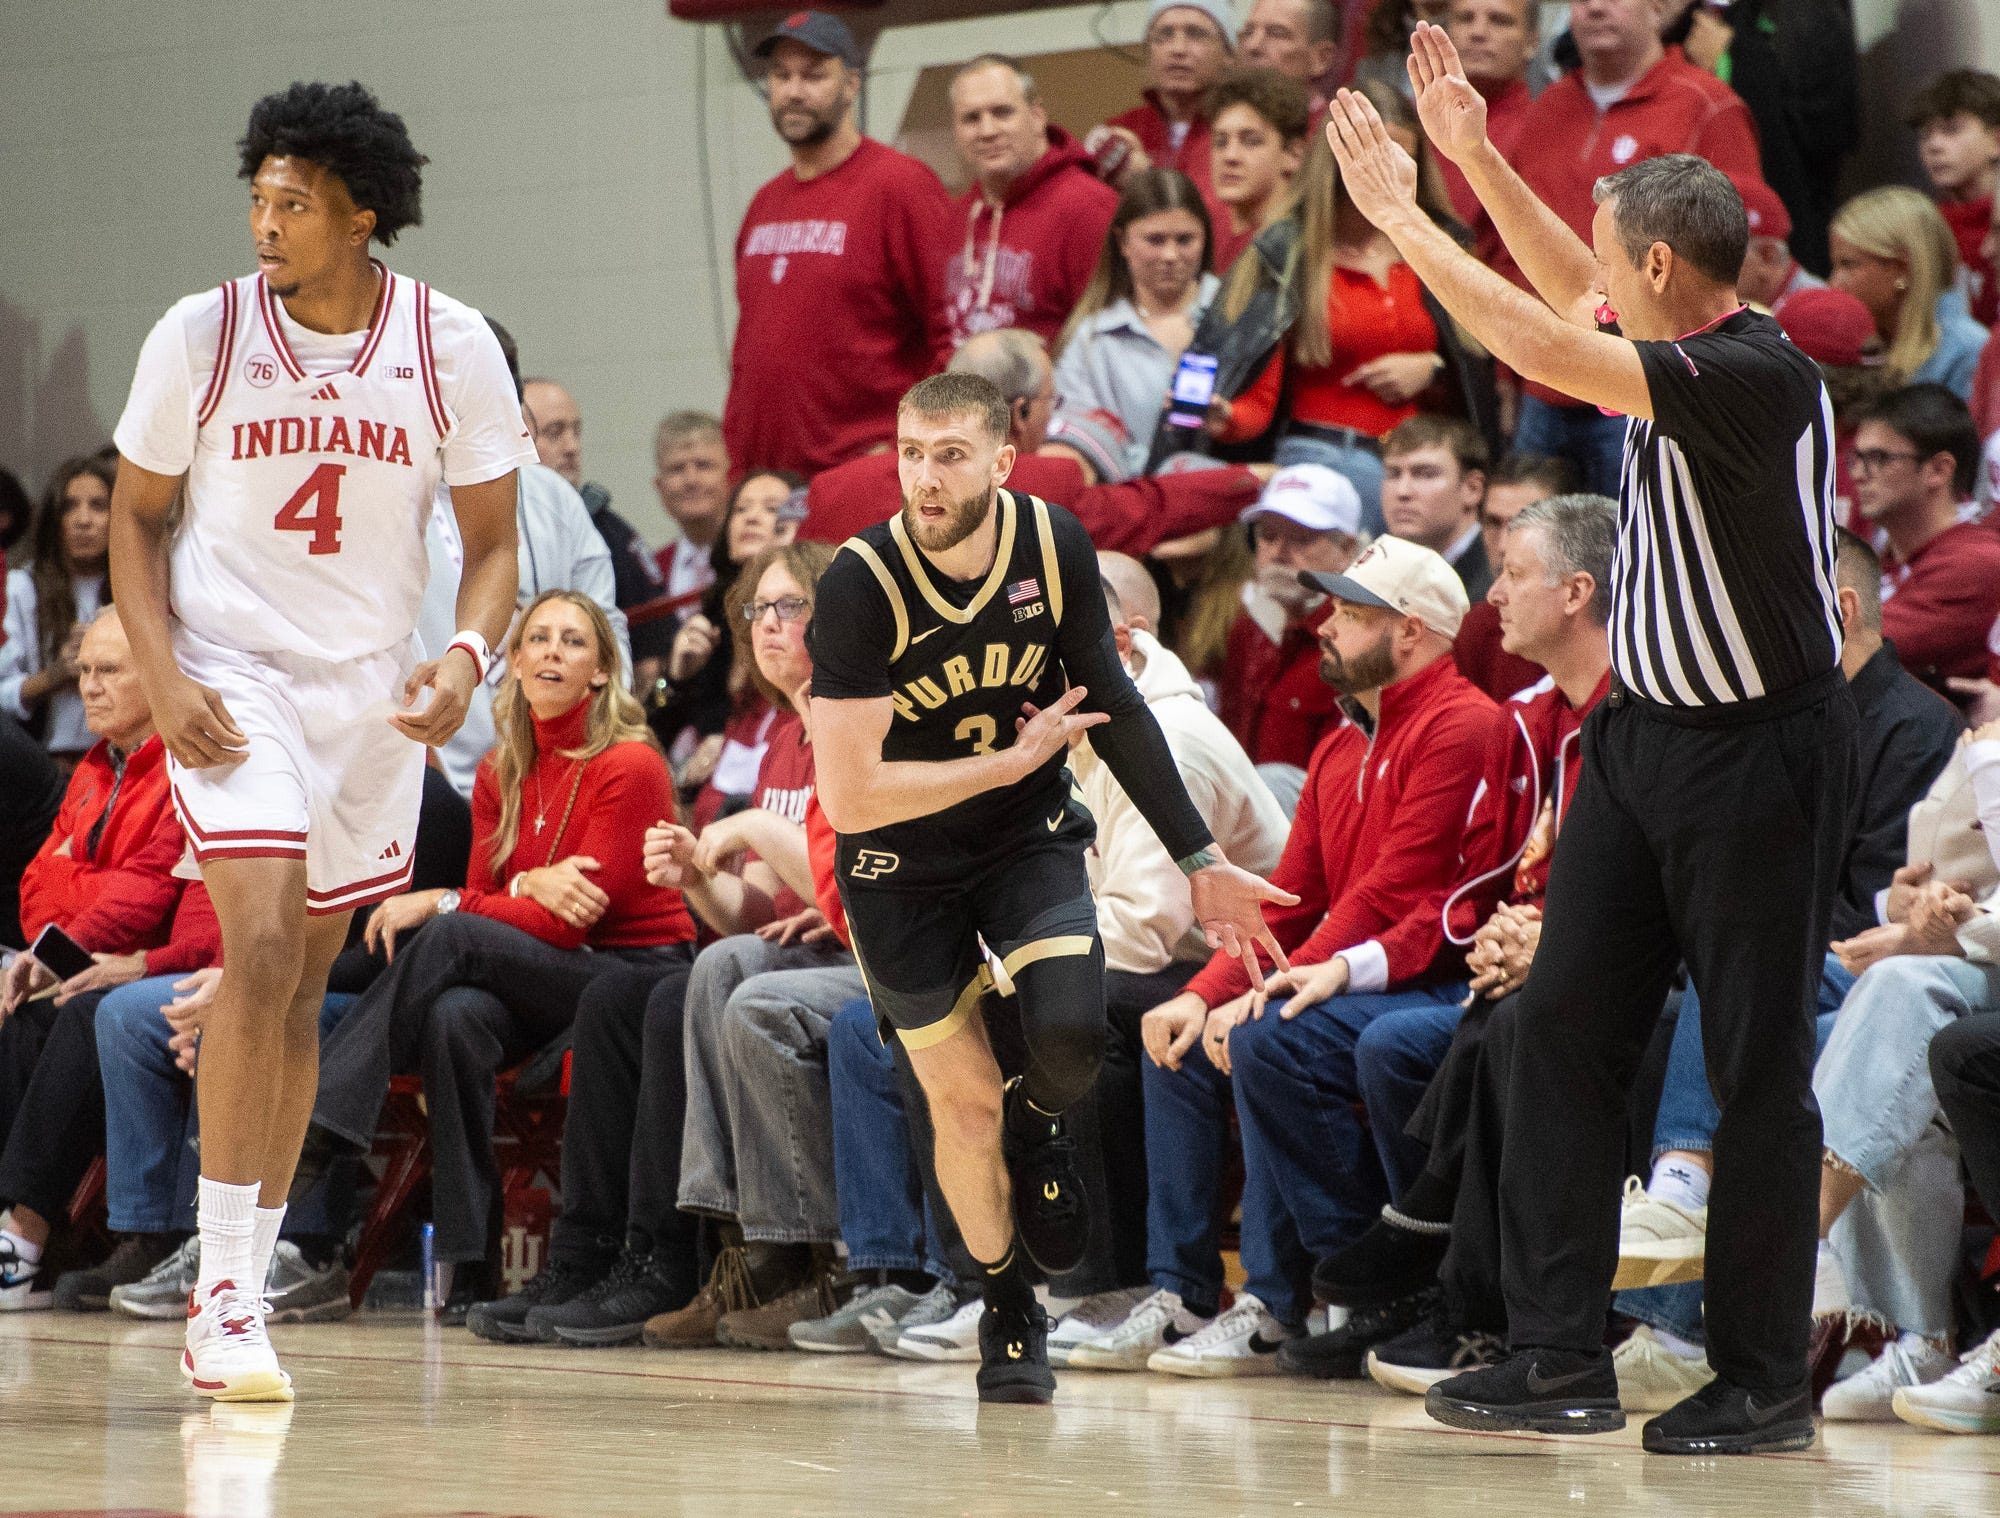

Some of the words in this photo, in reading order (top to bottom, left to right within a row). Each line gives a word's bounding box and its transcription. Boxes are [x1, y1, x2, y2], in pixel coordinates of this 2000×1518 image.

[232, 416, 413, 467] INDIANA
[274, 463, 347, 555] 4
[954, 713, 997, 757] 3
[851, 848, 900, 880] P
